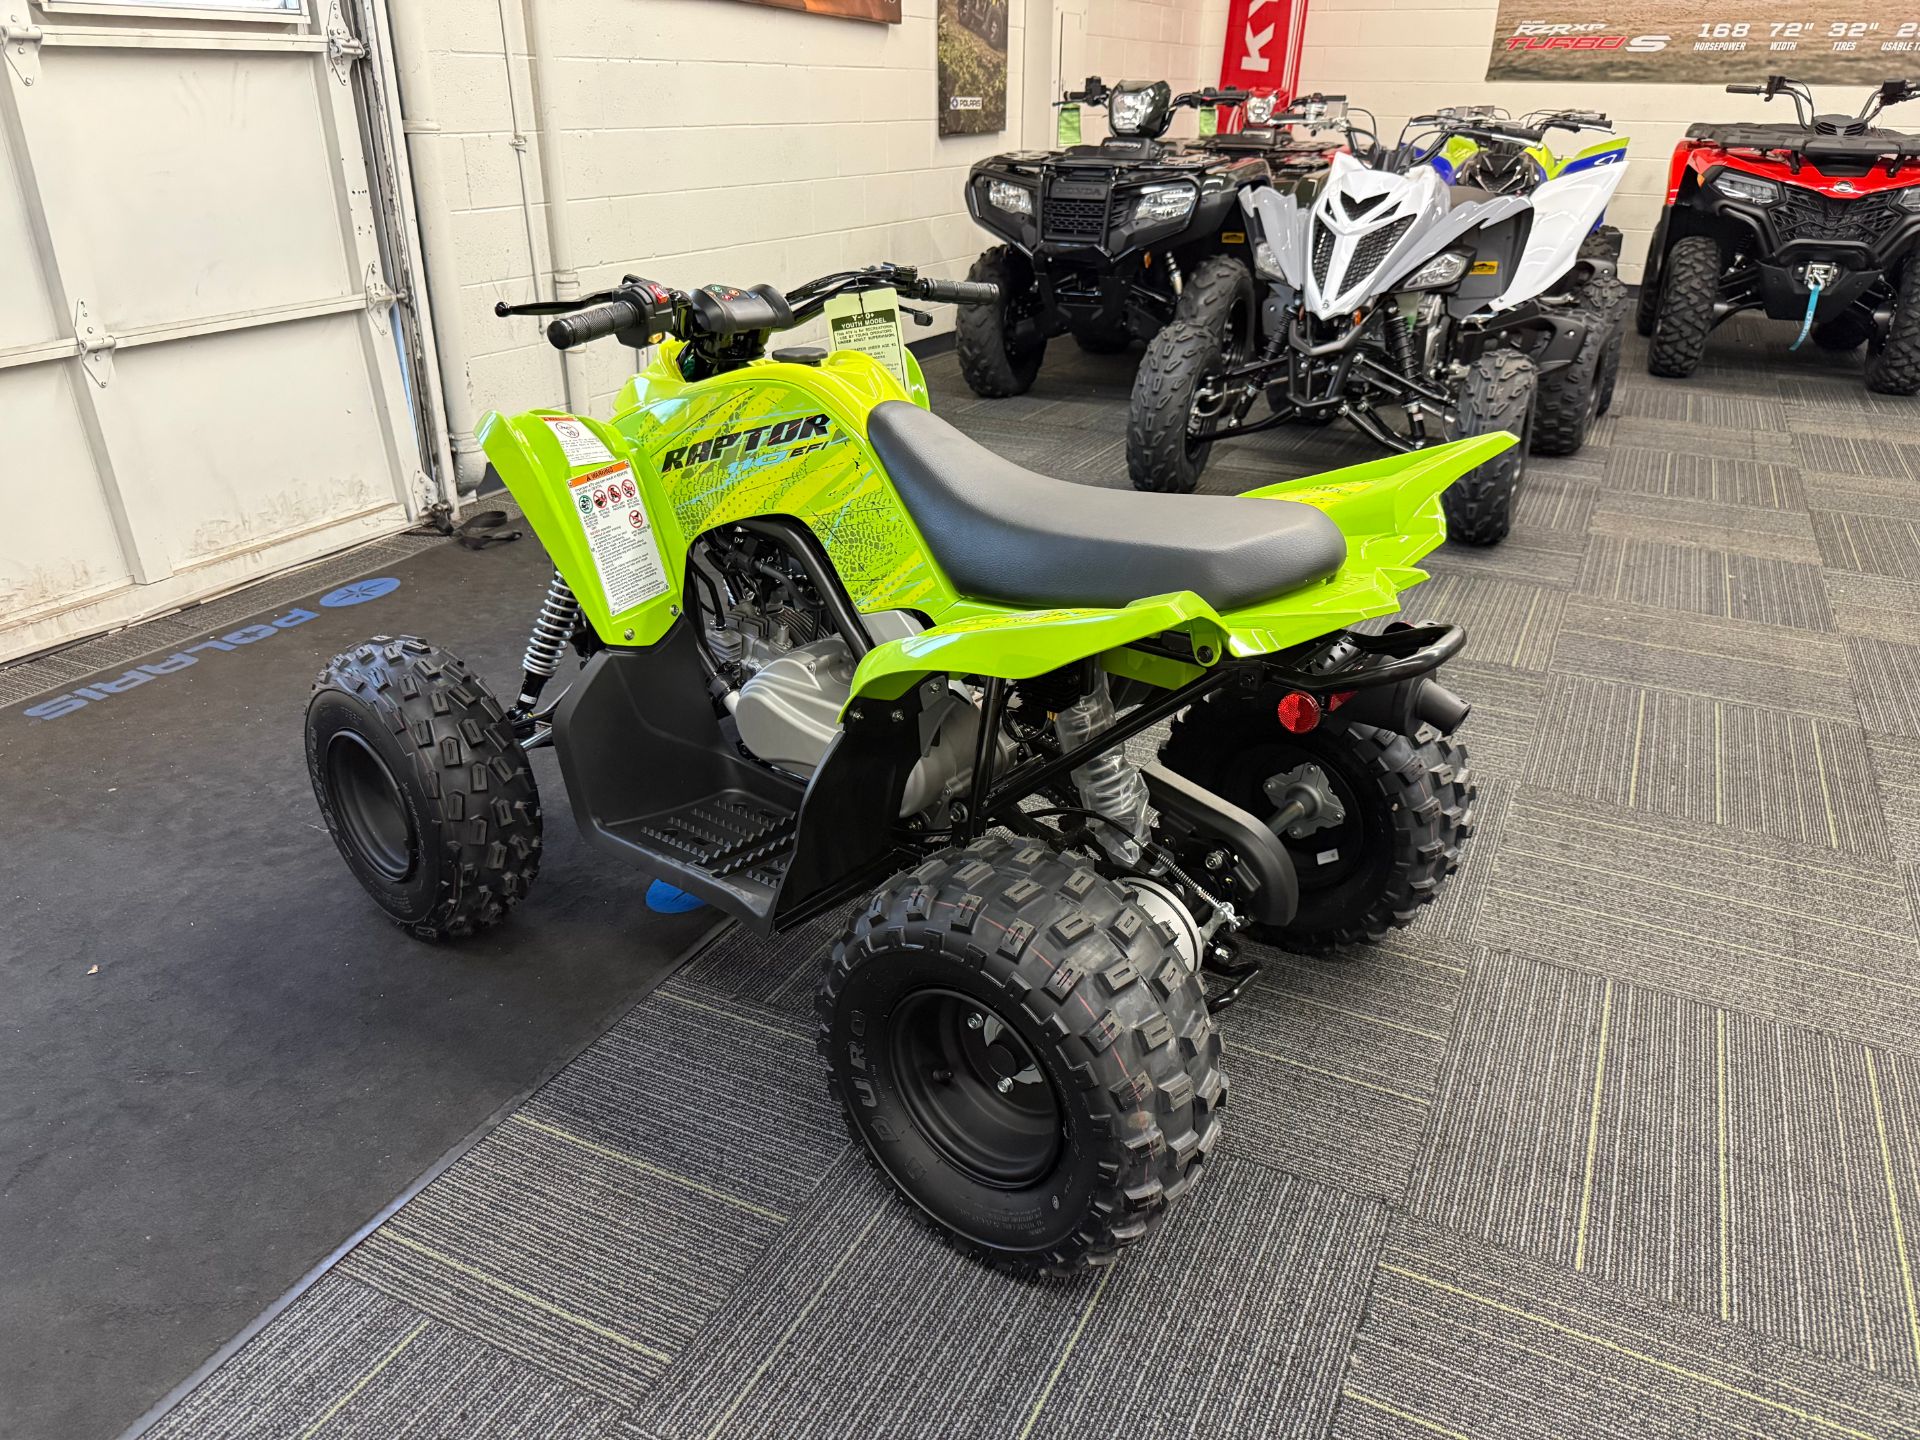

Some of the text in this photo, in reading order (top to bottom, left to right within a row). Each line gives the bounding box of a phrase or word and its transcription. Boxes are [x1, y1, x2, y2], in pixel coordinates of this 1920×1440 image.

[1512, 23, 1607, 36] RZR XP
[1697, 22, 1751, 38] 168
[1769, 22, 1815, 38] 72"
[1827, 22, 1880, 38] 32"
[1896, 22, 1920, 38] 2
[1505, 35, 1672, 53] TURBO S
[1693, 41, 1747, 51] HORSEPOWER
[1769, 41, 1798, 51] WIDTH
[1832, 41, 1857, 51] TIRES
[1881, 41, 1915, 51] USABLE
[960, 99, 981, 107] POLARIS
[841, 317, 887, 329] YOUTH MODEL
[852, 312, 875, 321] Y-0+
[661, 413, 832, 473] RAPTOR
[726, 441, 829, 475] 110 EFI
[591, 466, 614, 479] WARNING
[22, 607, 320, 721] POLARIS
[848, 1010, 901, 1142] DURO
